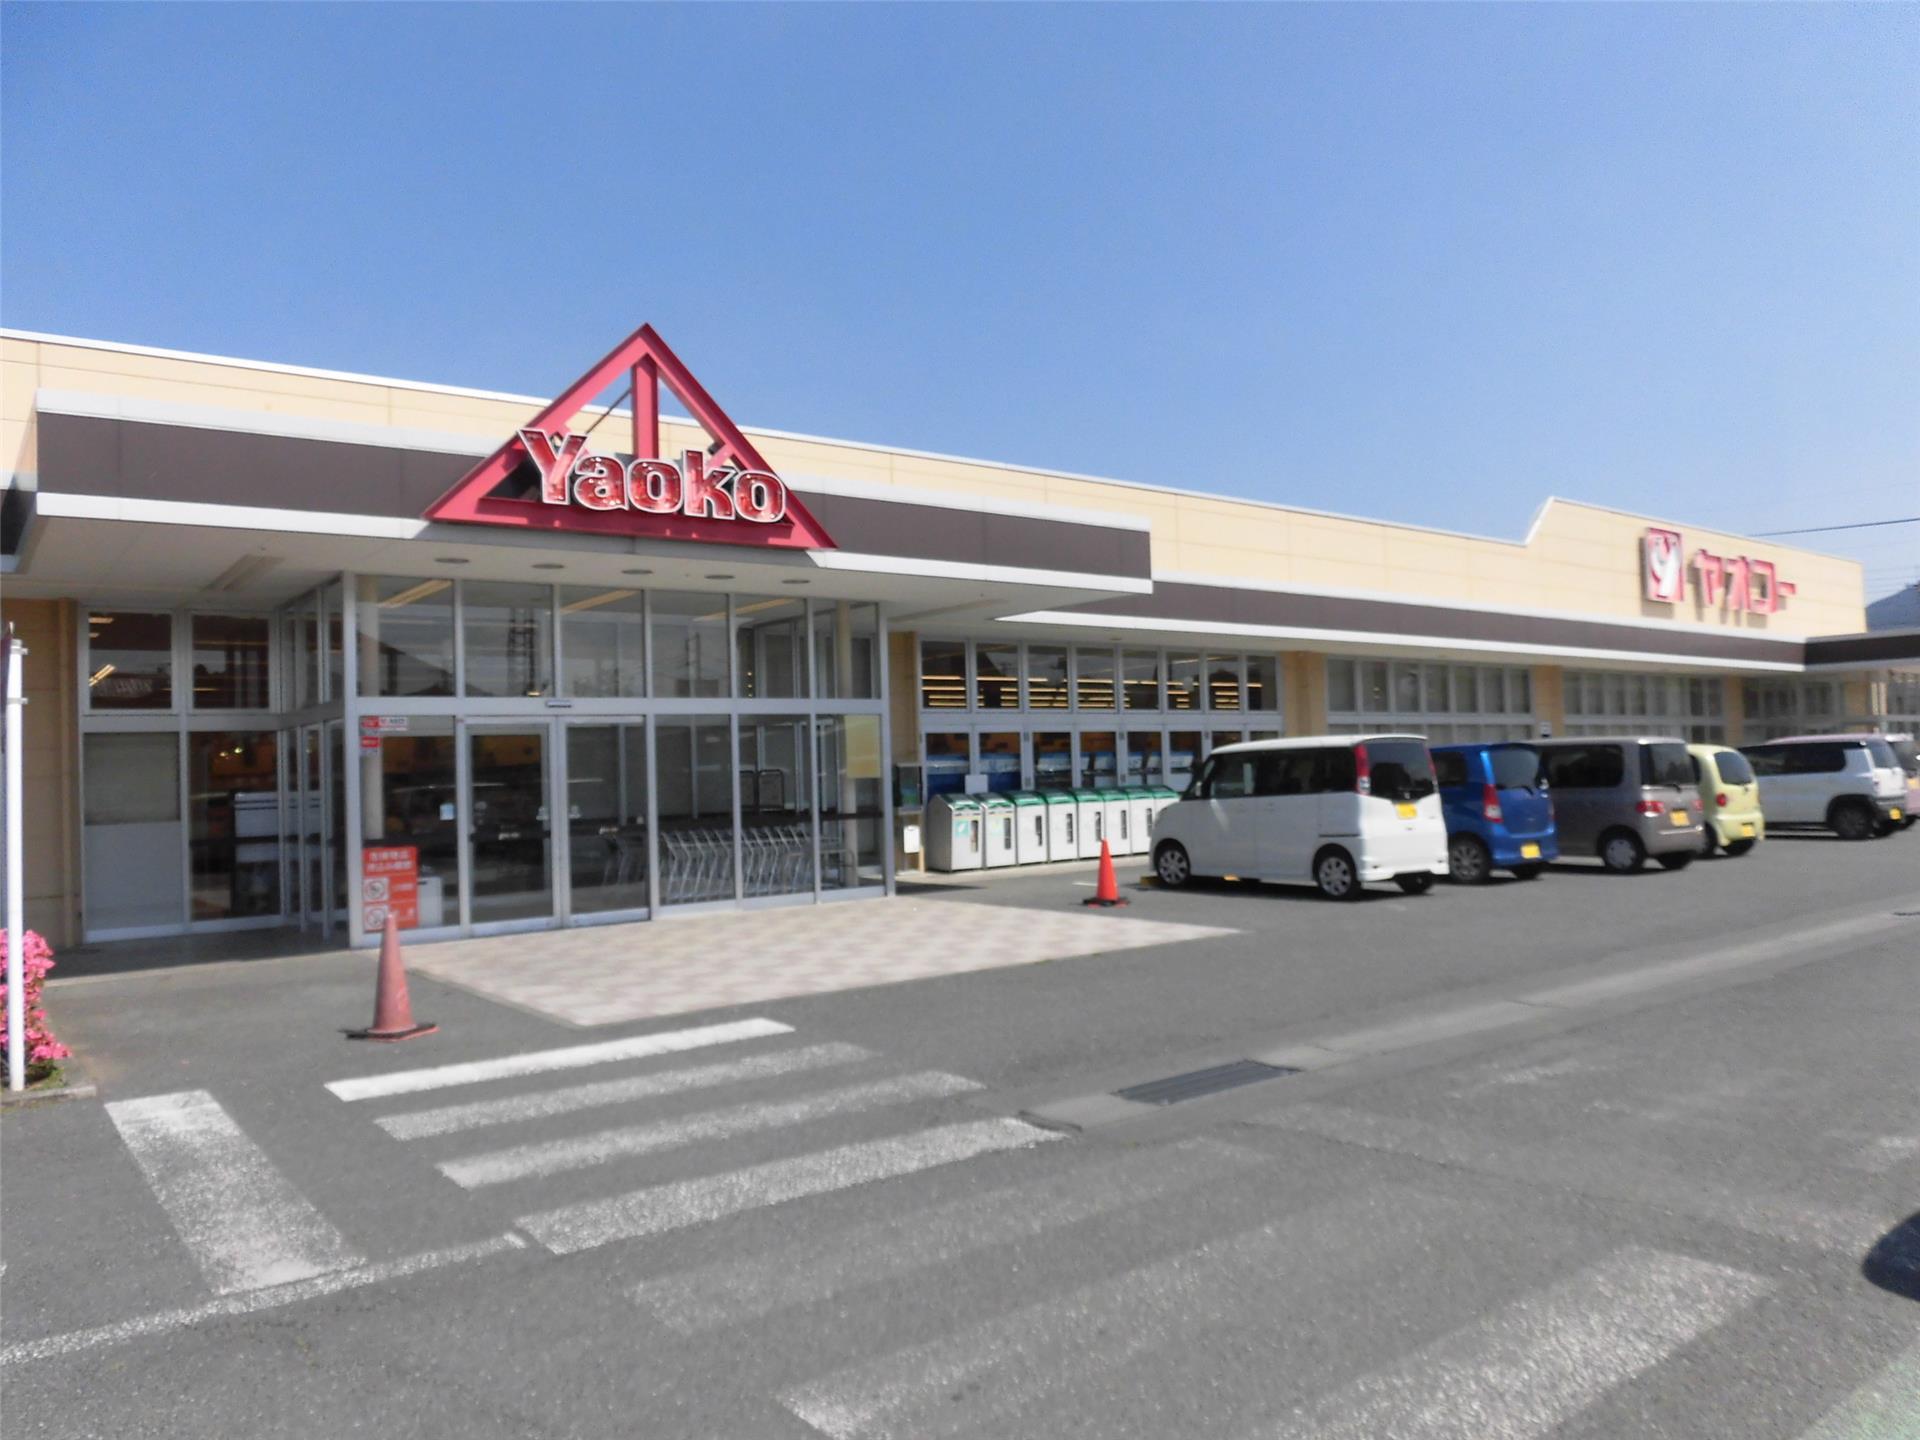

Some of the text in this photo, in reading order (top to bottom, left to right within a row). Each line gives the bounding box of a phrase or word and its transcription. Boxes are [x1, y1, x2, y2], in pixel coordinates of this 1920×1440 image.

[518, 428, 787, 523] Yaoko
[1692, 548, 1797, 614] ヤオコー
